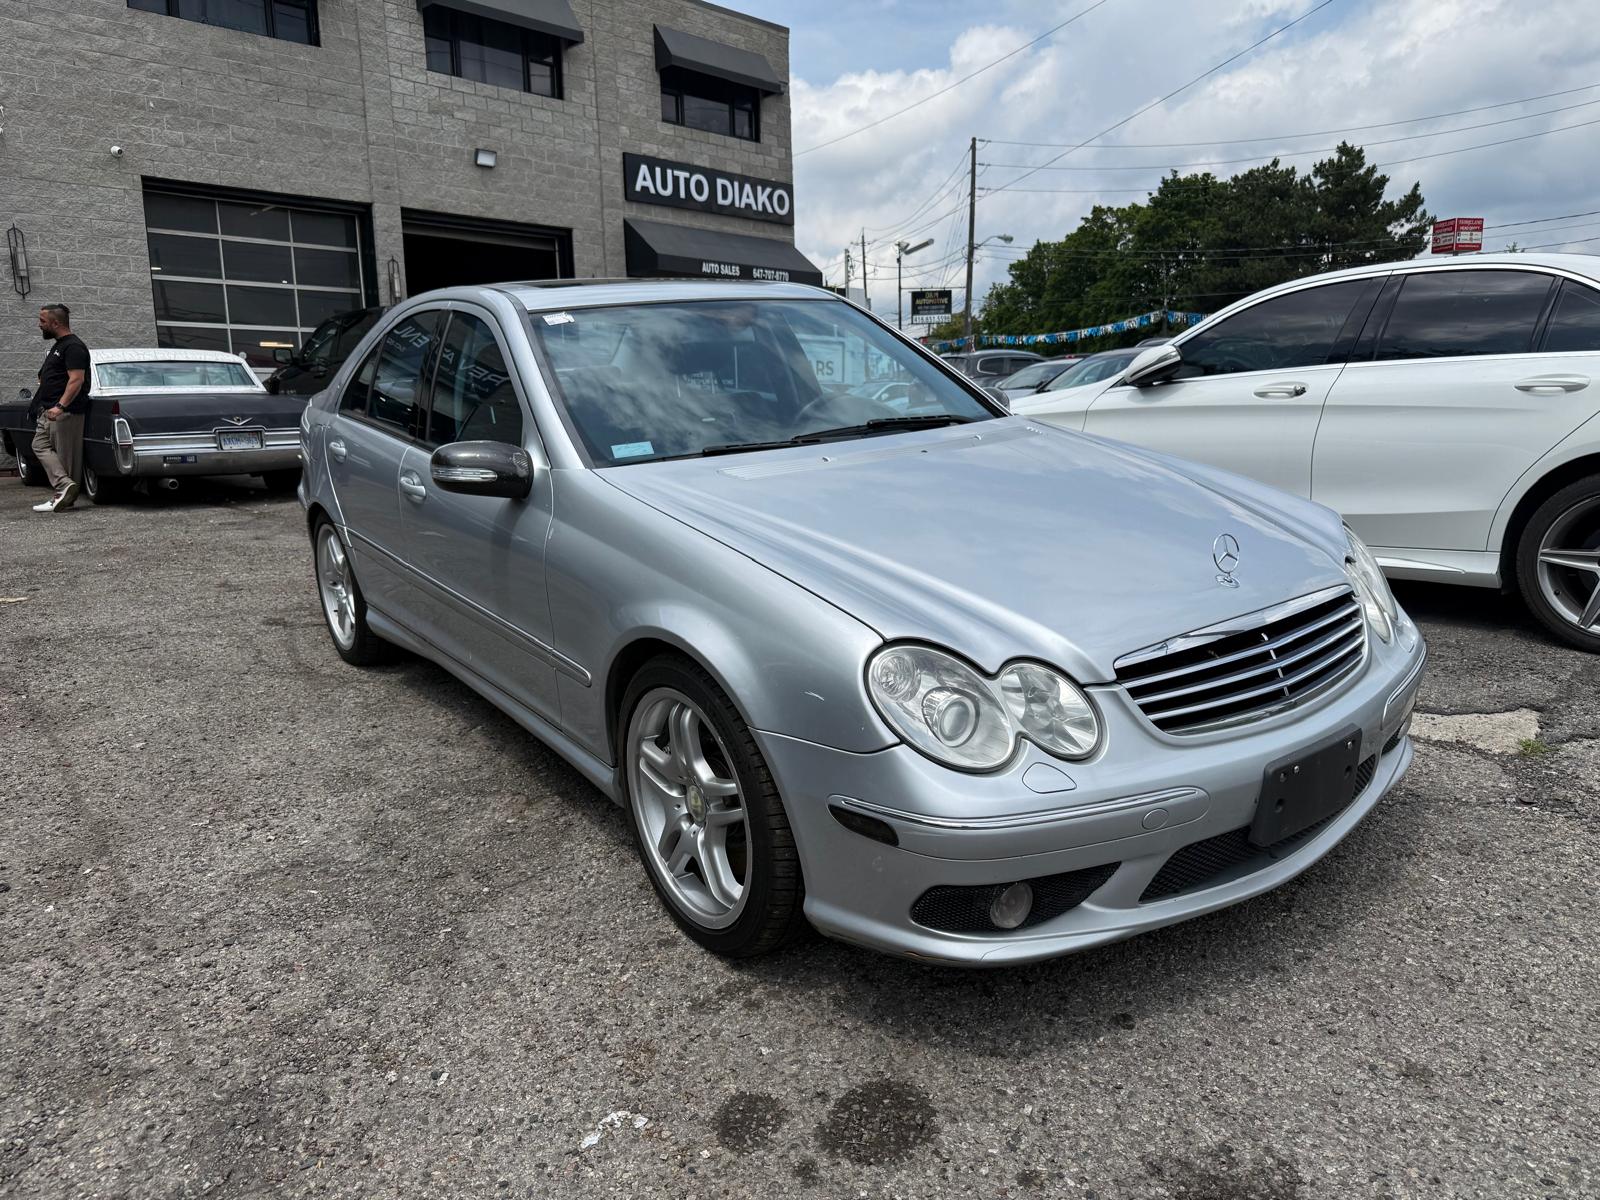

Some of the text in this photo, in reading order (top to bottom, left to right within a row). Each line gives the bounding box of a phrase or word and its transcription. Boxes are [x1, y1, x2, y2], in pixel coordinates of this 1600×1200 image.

[635, 164, 790, 215] AUTO DIAKO
[702, 262, 719, 274] AUTO
[720, 264, 740, 276] SALES
